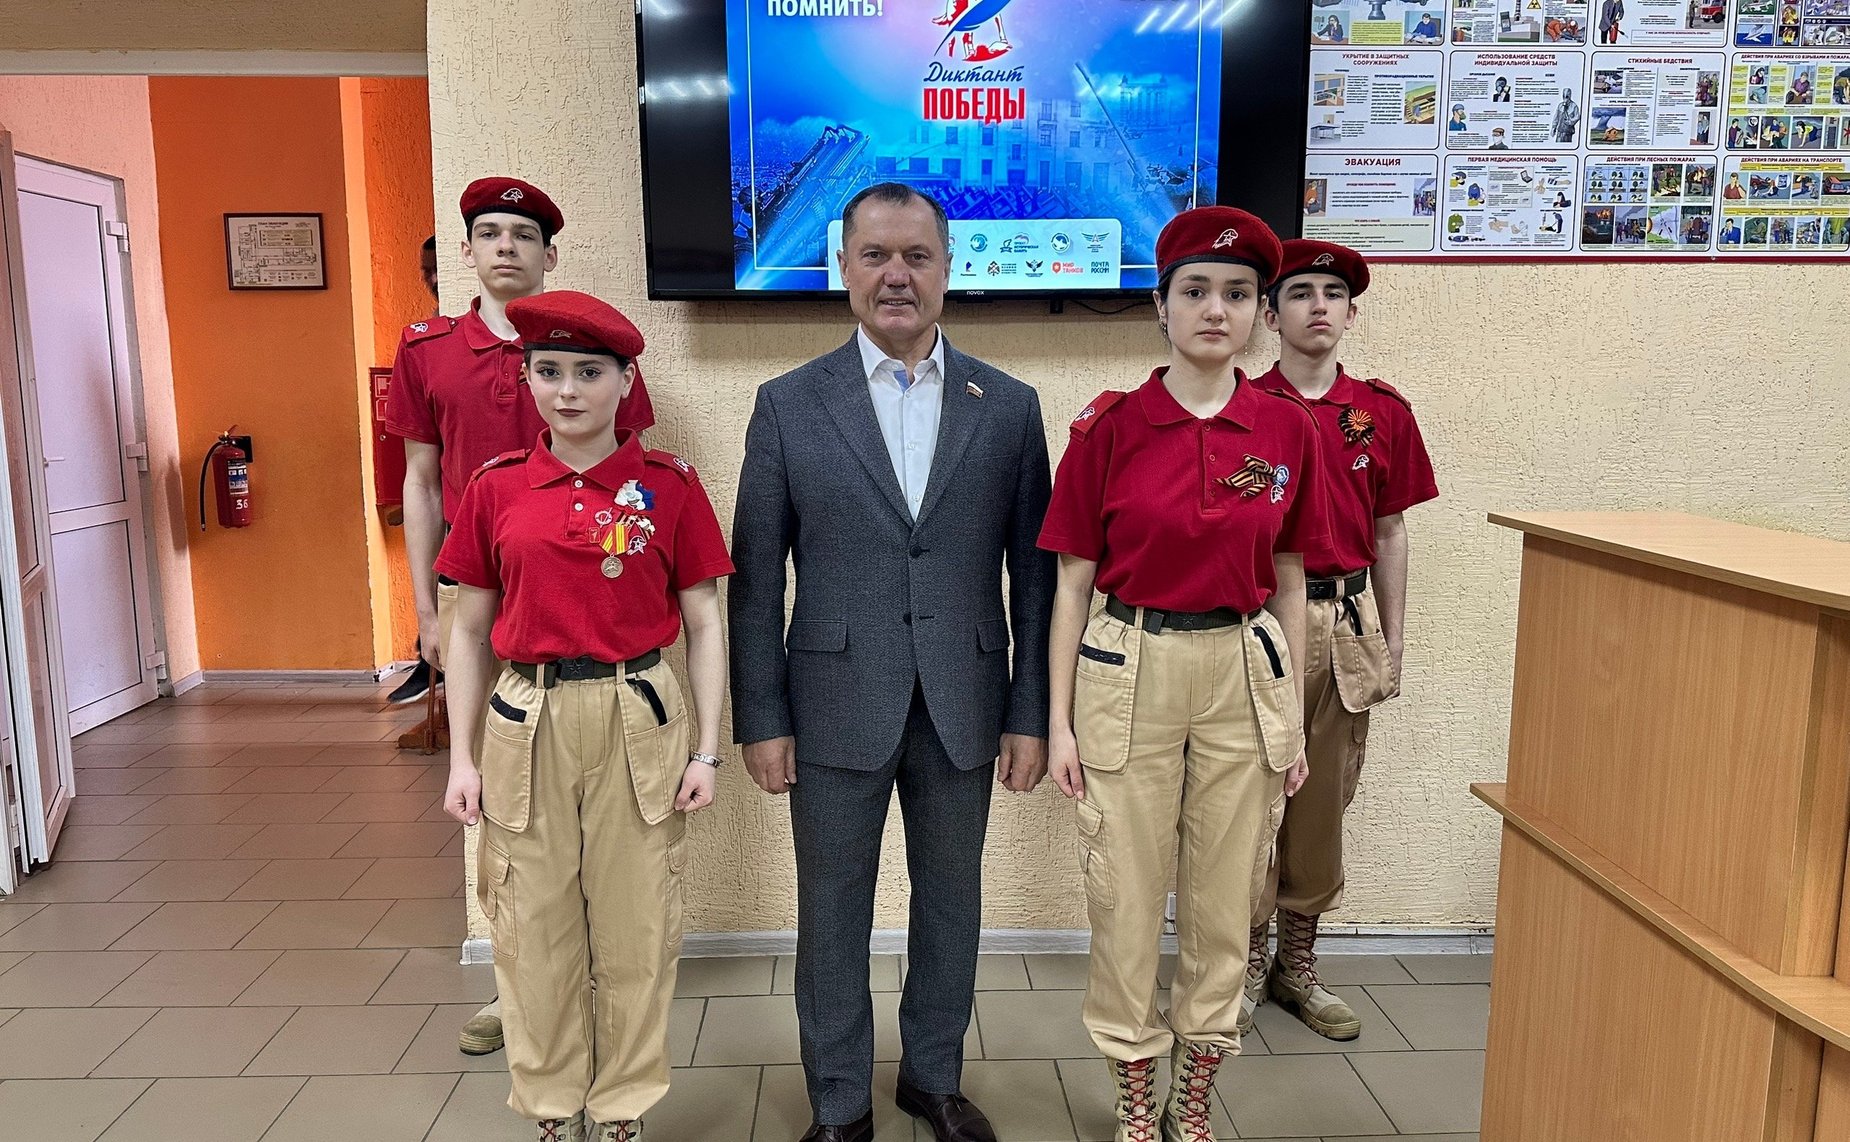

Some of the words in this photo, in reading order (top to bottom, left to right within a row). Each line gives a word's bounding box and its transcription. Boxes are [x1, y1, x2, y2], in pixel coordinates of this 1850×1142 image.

[767, 0, 883, 17] ПОМНИТЬ!
[923, 61, 1025, 83] Диктант
[923, 88, 1025, 125] ПОБЕДЫ
[1344, 158, 1401, 167] ЭВАКУАЦИЯ
